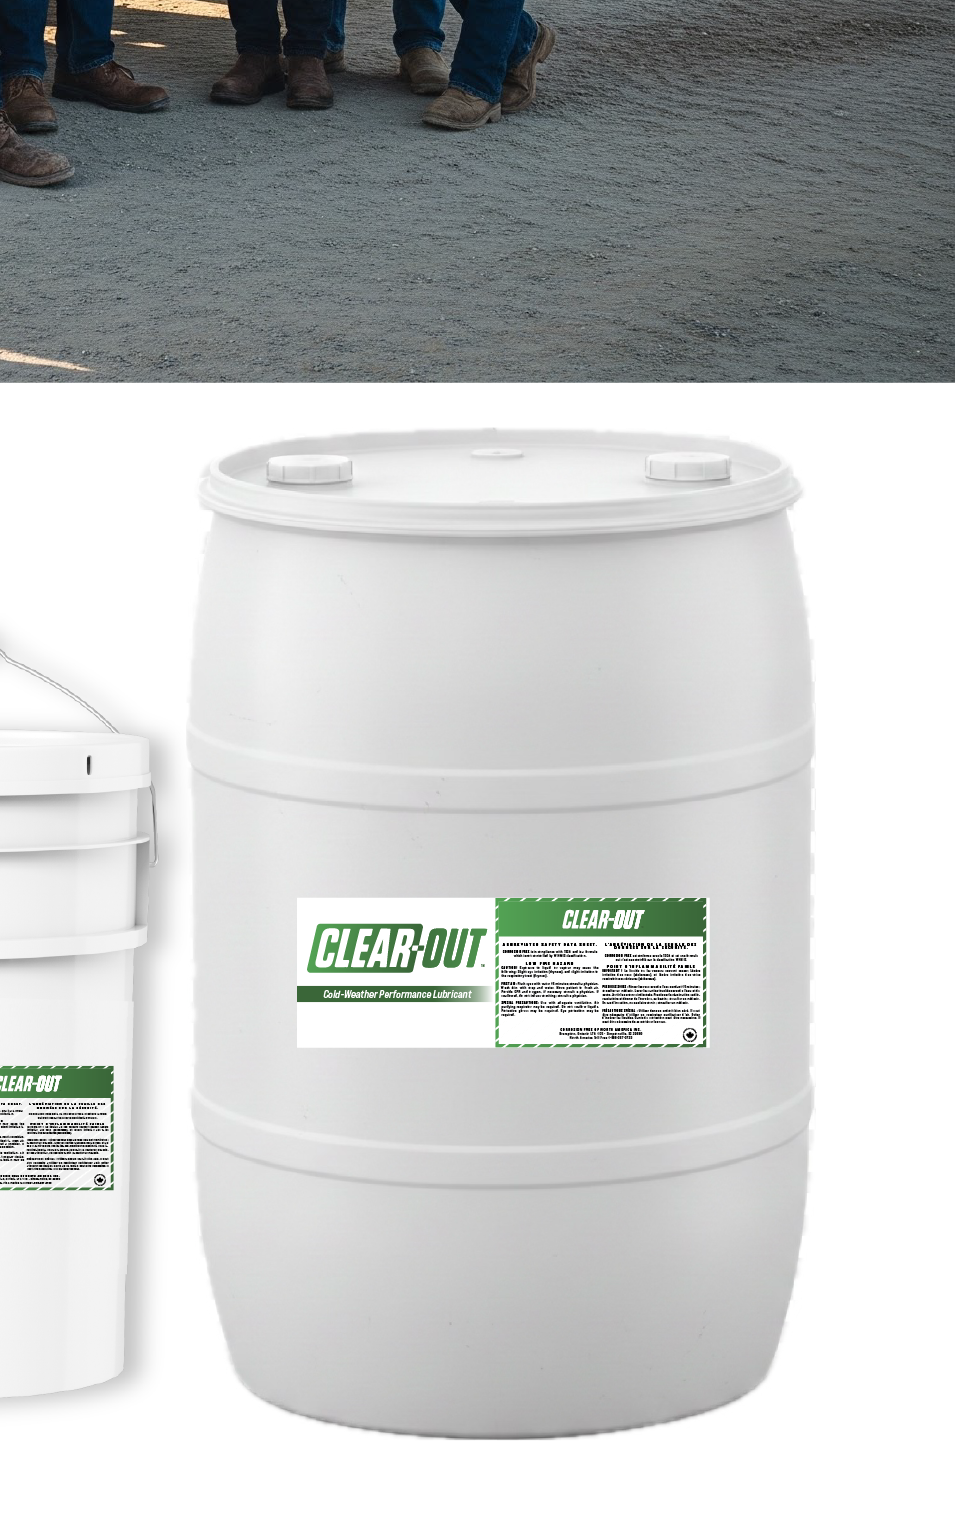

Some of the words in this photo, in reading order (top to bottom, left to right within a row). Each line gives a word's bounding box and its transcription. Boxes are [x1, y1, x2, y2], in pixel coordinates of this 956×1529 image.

[561, 909, 646, 930] CLEAR-OUT
[314, 928, 488, 969] CLEAR-OUT
[322, 989, 378, 1000] Cold-Weather
[378, 989, 432, 1000] Performance
[432, 989, 473, 1000] Lubricant
